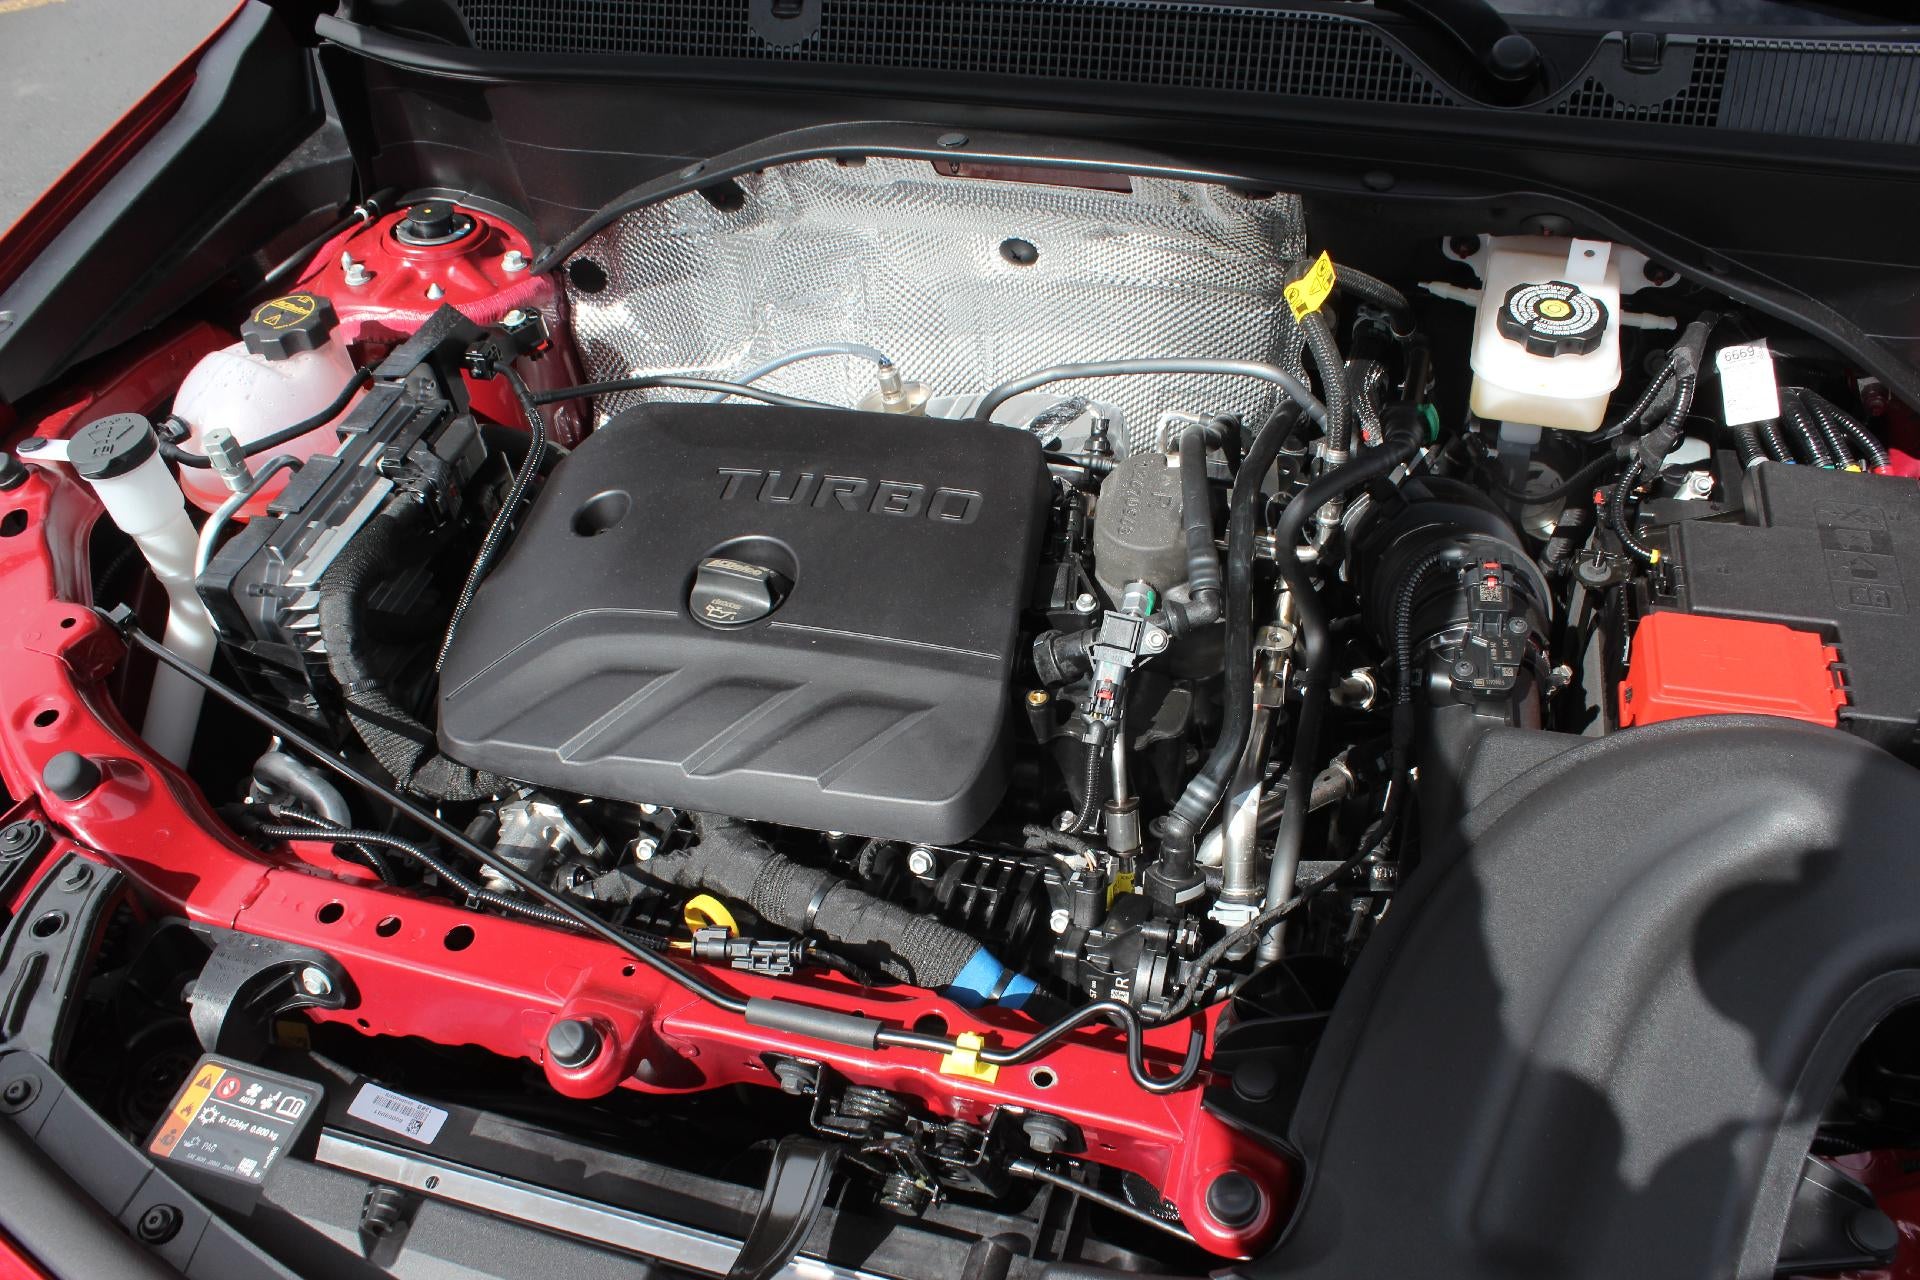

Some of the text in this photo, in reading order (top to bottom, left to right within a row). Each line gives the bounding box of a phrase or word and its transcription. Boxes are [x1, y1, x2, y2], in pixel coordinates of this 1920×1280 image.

[716, 466, 983, 525] TURBO
[239, 1096, 256, 1106] AUTO
[218, 1115, 250, 1131] R-1234yf
[269, 1130, 280, 1141] kg
